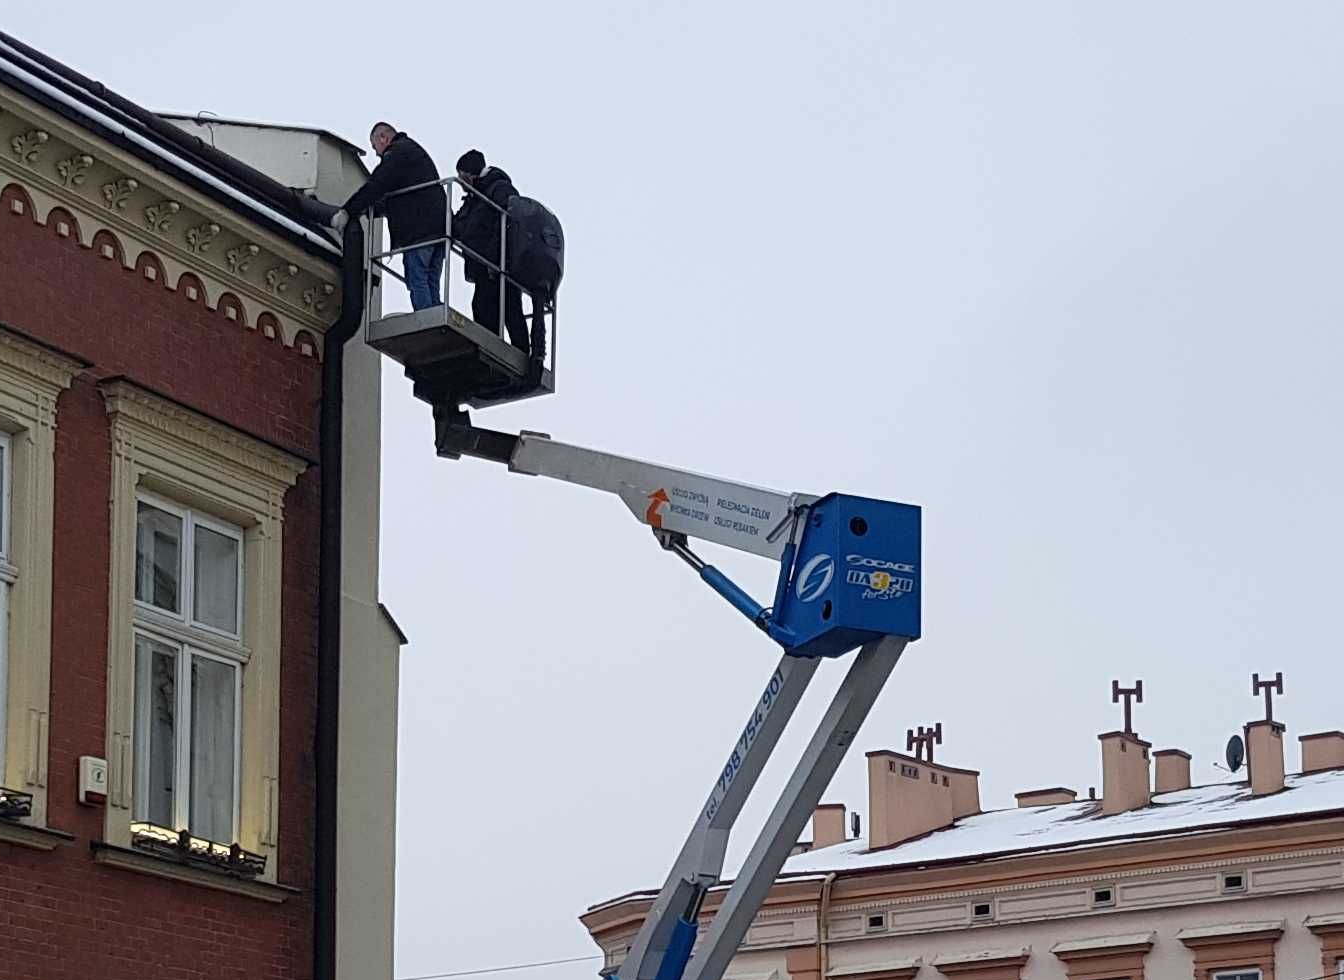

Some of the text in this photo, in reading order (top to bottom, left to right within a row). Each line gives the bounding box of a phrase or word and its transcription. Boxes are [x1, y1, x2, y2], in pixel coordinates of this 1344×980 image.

[718, 751, 742, 793] 798
[740, 711, 763, 751] 754
[762, 667, 784, 710] 901
